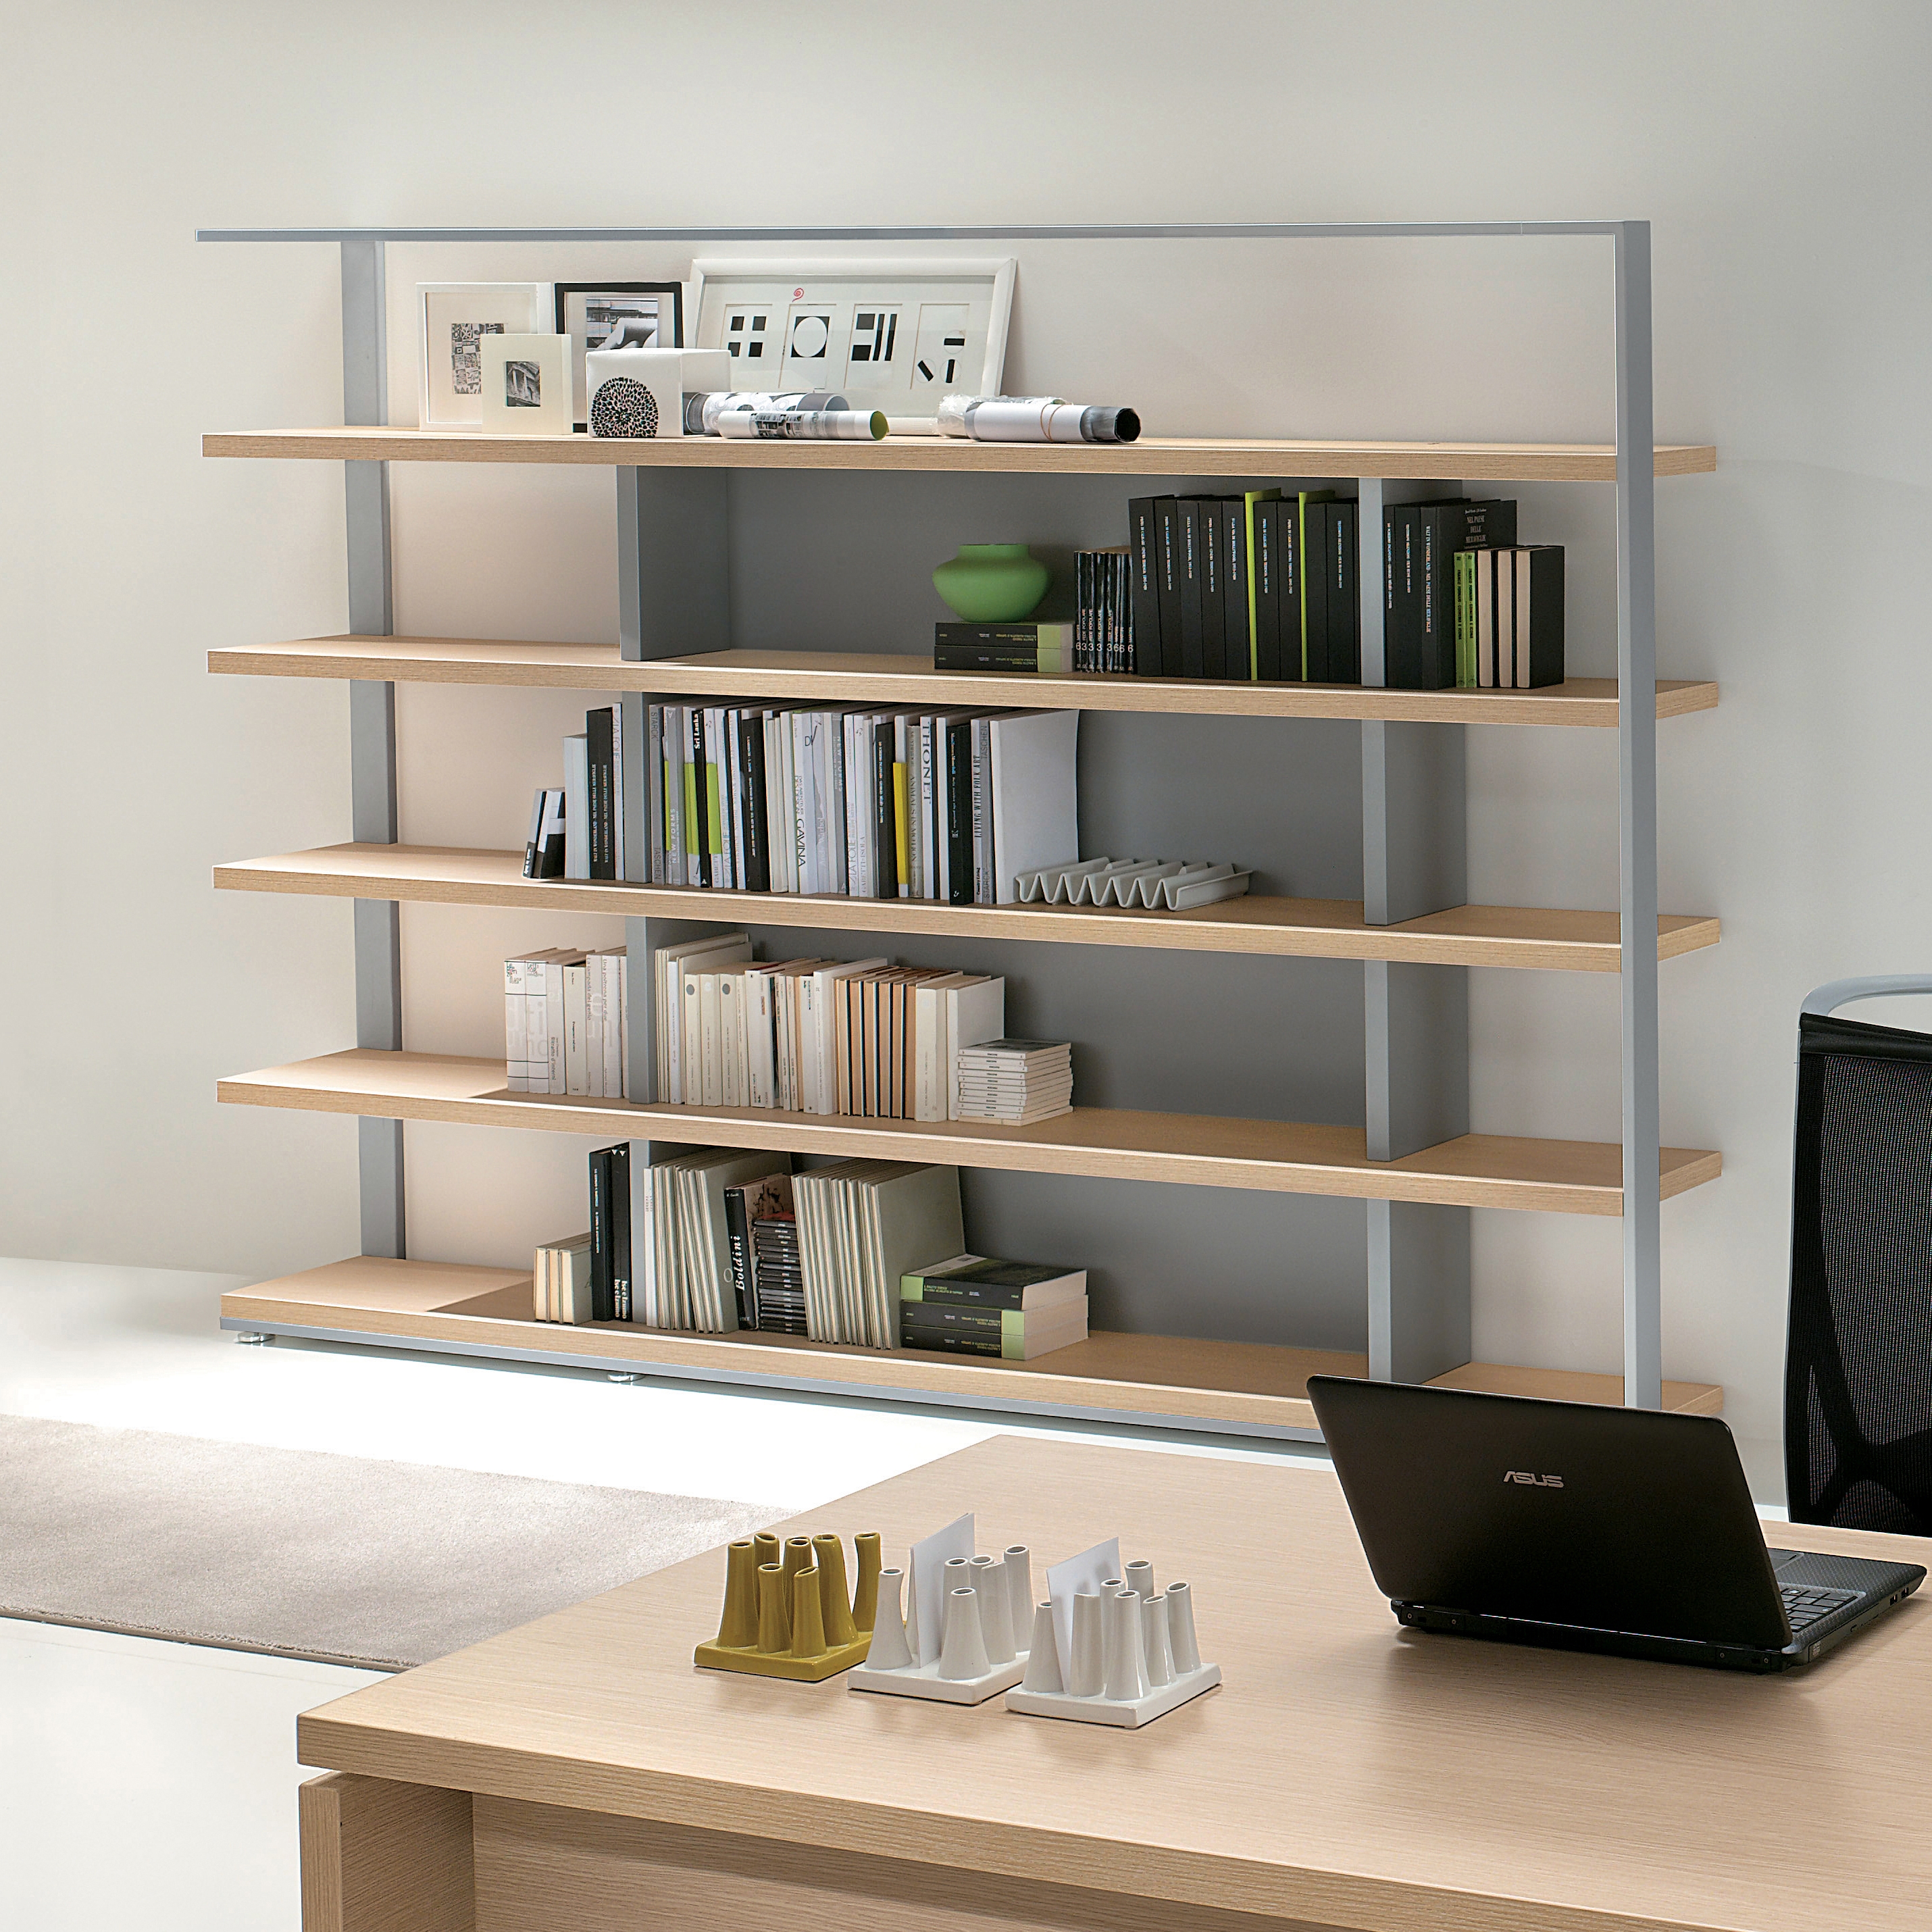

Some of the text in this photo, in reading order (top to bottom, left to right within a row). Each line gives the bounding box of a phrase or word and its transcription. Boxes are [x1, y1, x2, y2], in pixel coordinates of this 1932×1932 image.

[923, 721, 931, 804] THONET
[651, 712, 662, 880] STARCK TASCHEN
[797, 819, 807, 867] GAVINA
[817, 817, 825, 844] Warhol
[974, 813, 982, 838] LIVING
[730, 1235, 745, 1291] Boldini
[1503, 1471, 1565, 1488] ASUS
